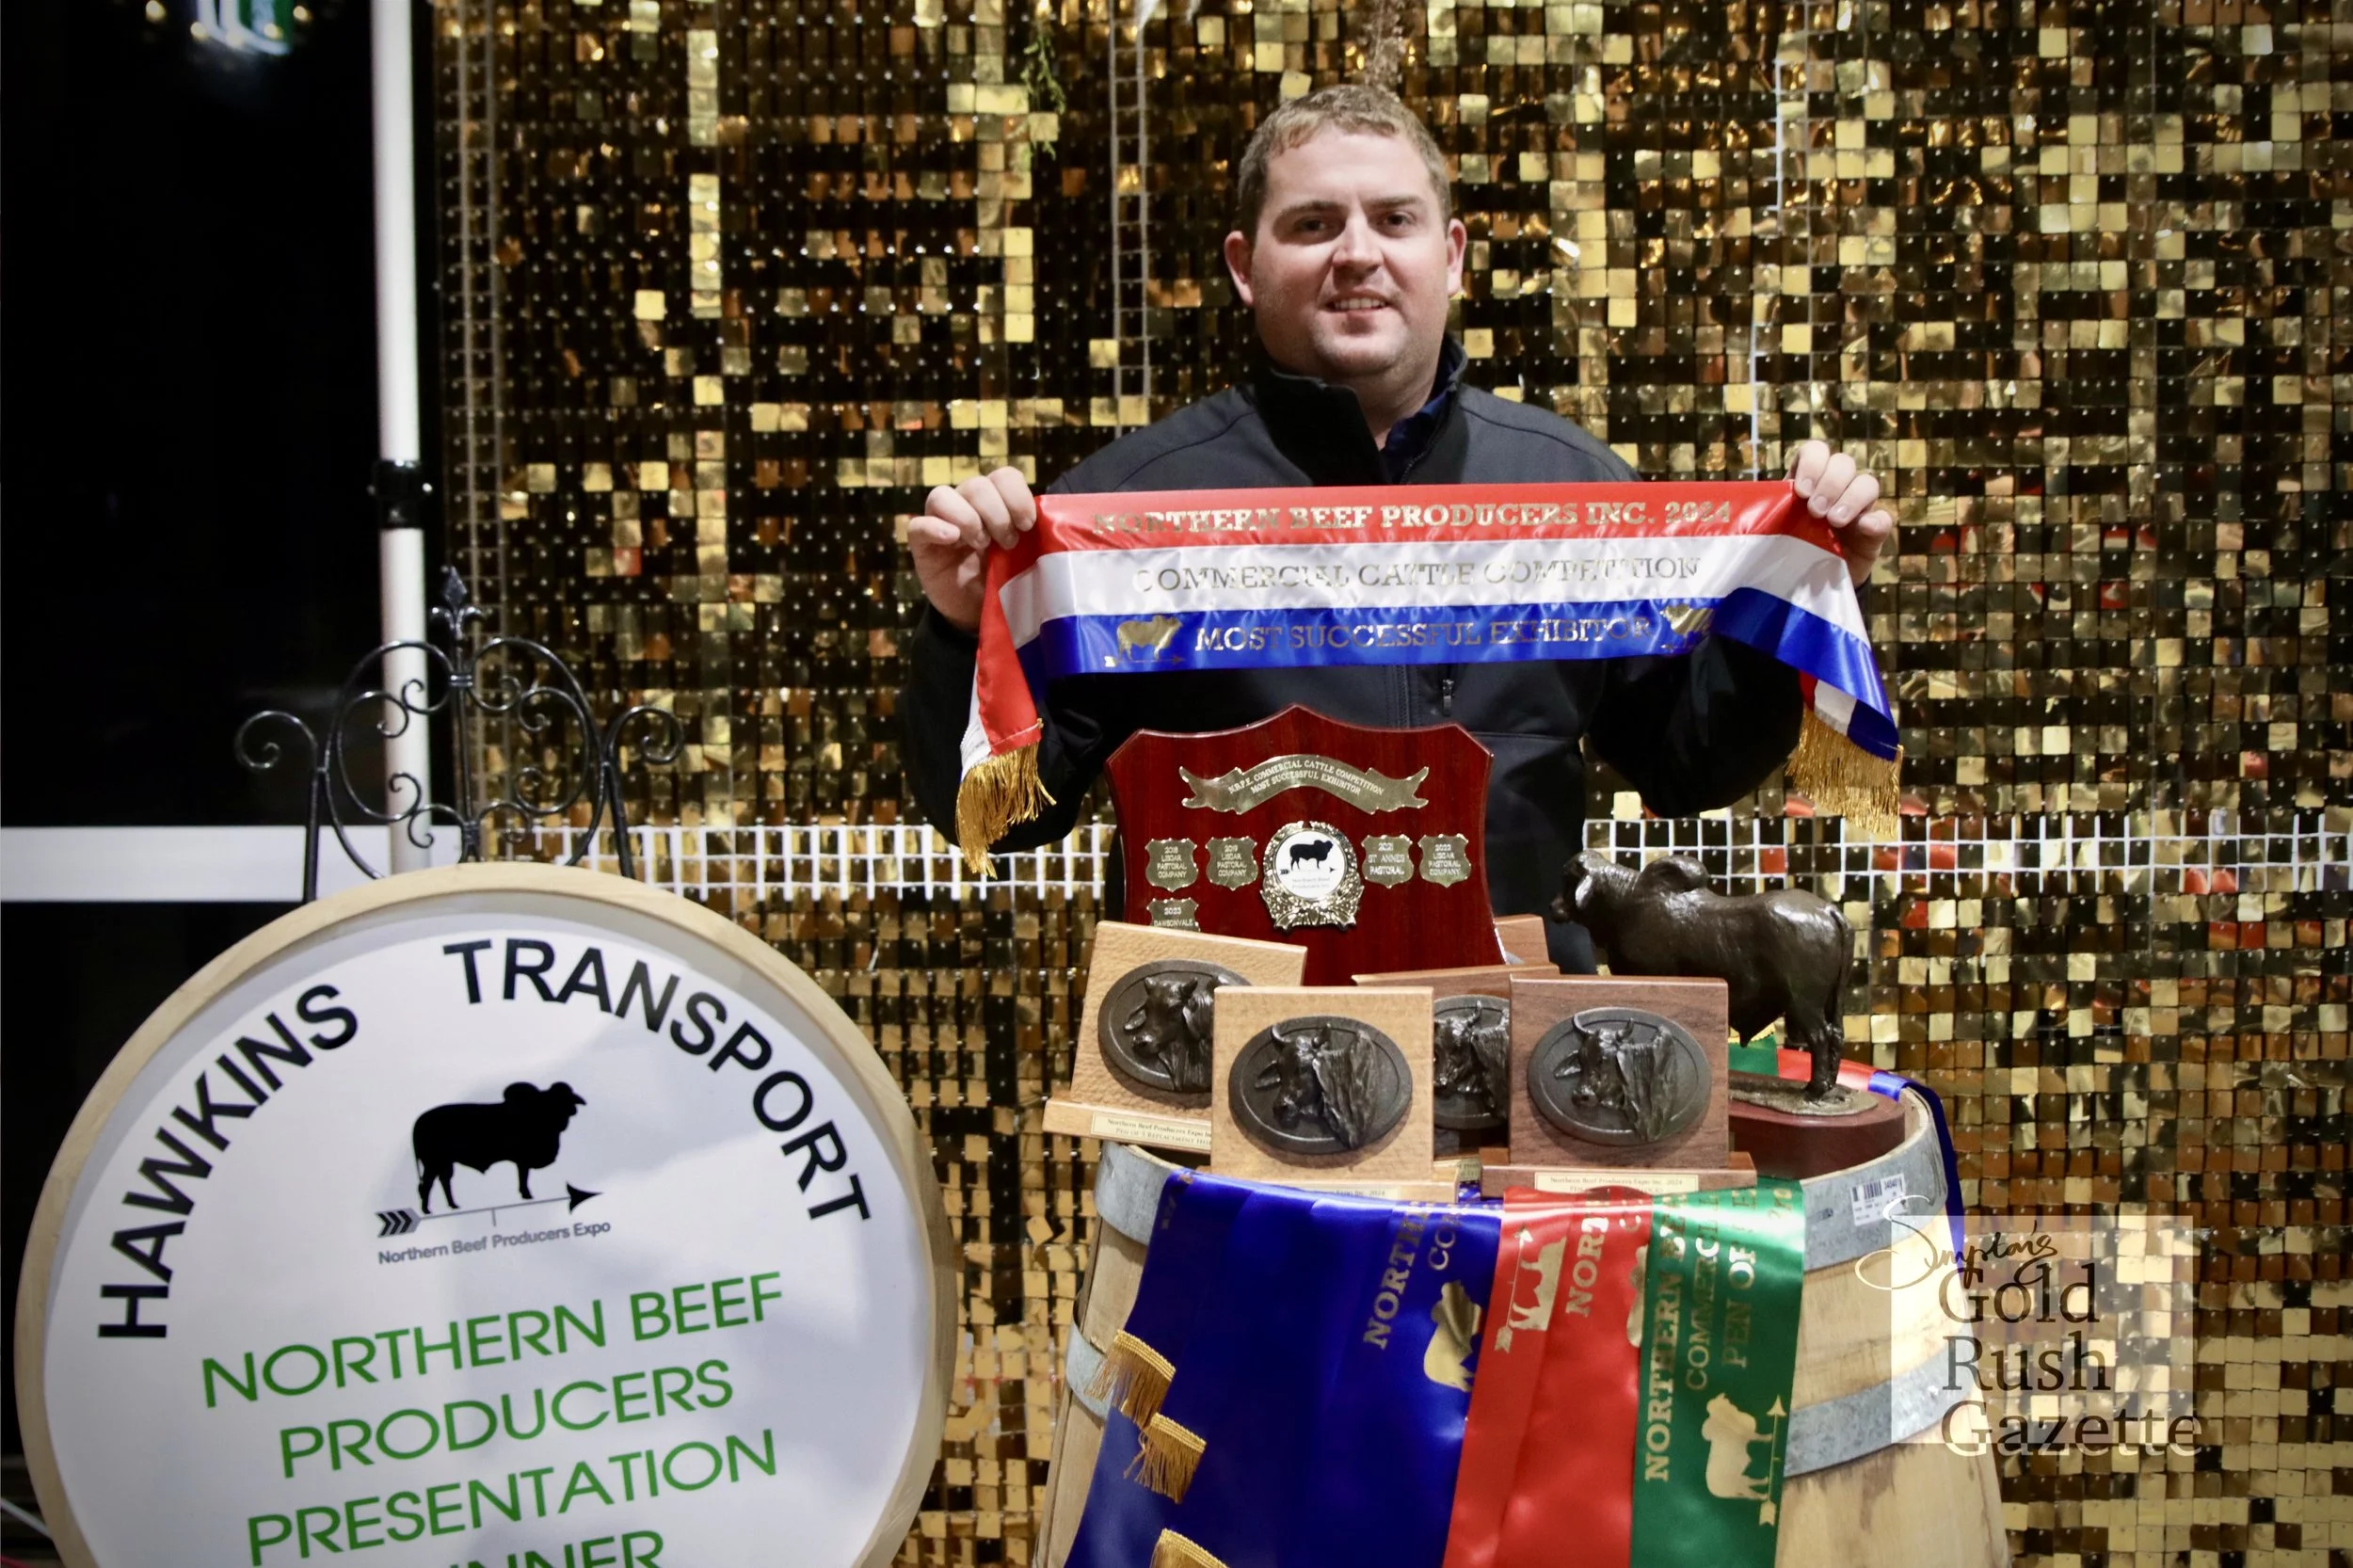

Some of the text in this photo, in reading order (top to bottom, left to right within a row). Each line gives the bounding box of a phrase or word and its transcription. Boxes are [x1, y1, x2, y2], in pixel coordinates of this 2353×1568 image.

[1093, 500, 1732, 535] NORTHERN BEEF PRODUCERS INC. 2024
[1132, 556, 1702, 592] COMMERCIAL CATTLE COMPETITION
[1194, 616, 1654, 652] MOST SUCCESSFUL EXHIBITOR
[1250, 769, 1361, 795] MOST SUCCESSFUL EXHIBITOR
[1254, 760, 1303, 781] COMMERCIAL
[1304, 760, 1335, 774] CATTLE
[1336, 767, 1385, 795] COMPETITION
[1157, 862, 1187, 871] PASTORAL
[1158, 871, 1187, 879] COMPANY
[1217, 860, 1247, 869] PASTORAL
[1218, 869, 1247, 877] COMPANY
[1369, 865, 1405, 875] PASTORAL
[1429, 868, 1461, 876] COMPANY
[1163, 906, 1182, 915] 2023
[97, 937, 872, 1338] HAWKINS TRANSPORT
[378, 1221, 611, 1264] Northern Beef Producers Expo
[201, 1271, 783, 1408] NORTHERN BEEF
[1721, 1296, 1752, 1368] PEN
[1643, 1272, 1683, 1483] NORTHERN
[280, 1359, 733, 1479] PRODUCERS
[248, 1429, 777, 1568] PRESENTATION
